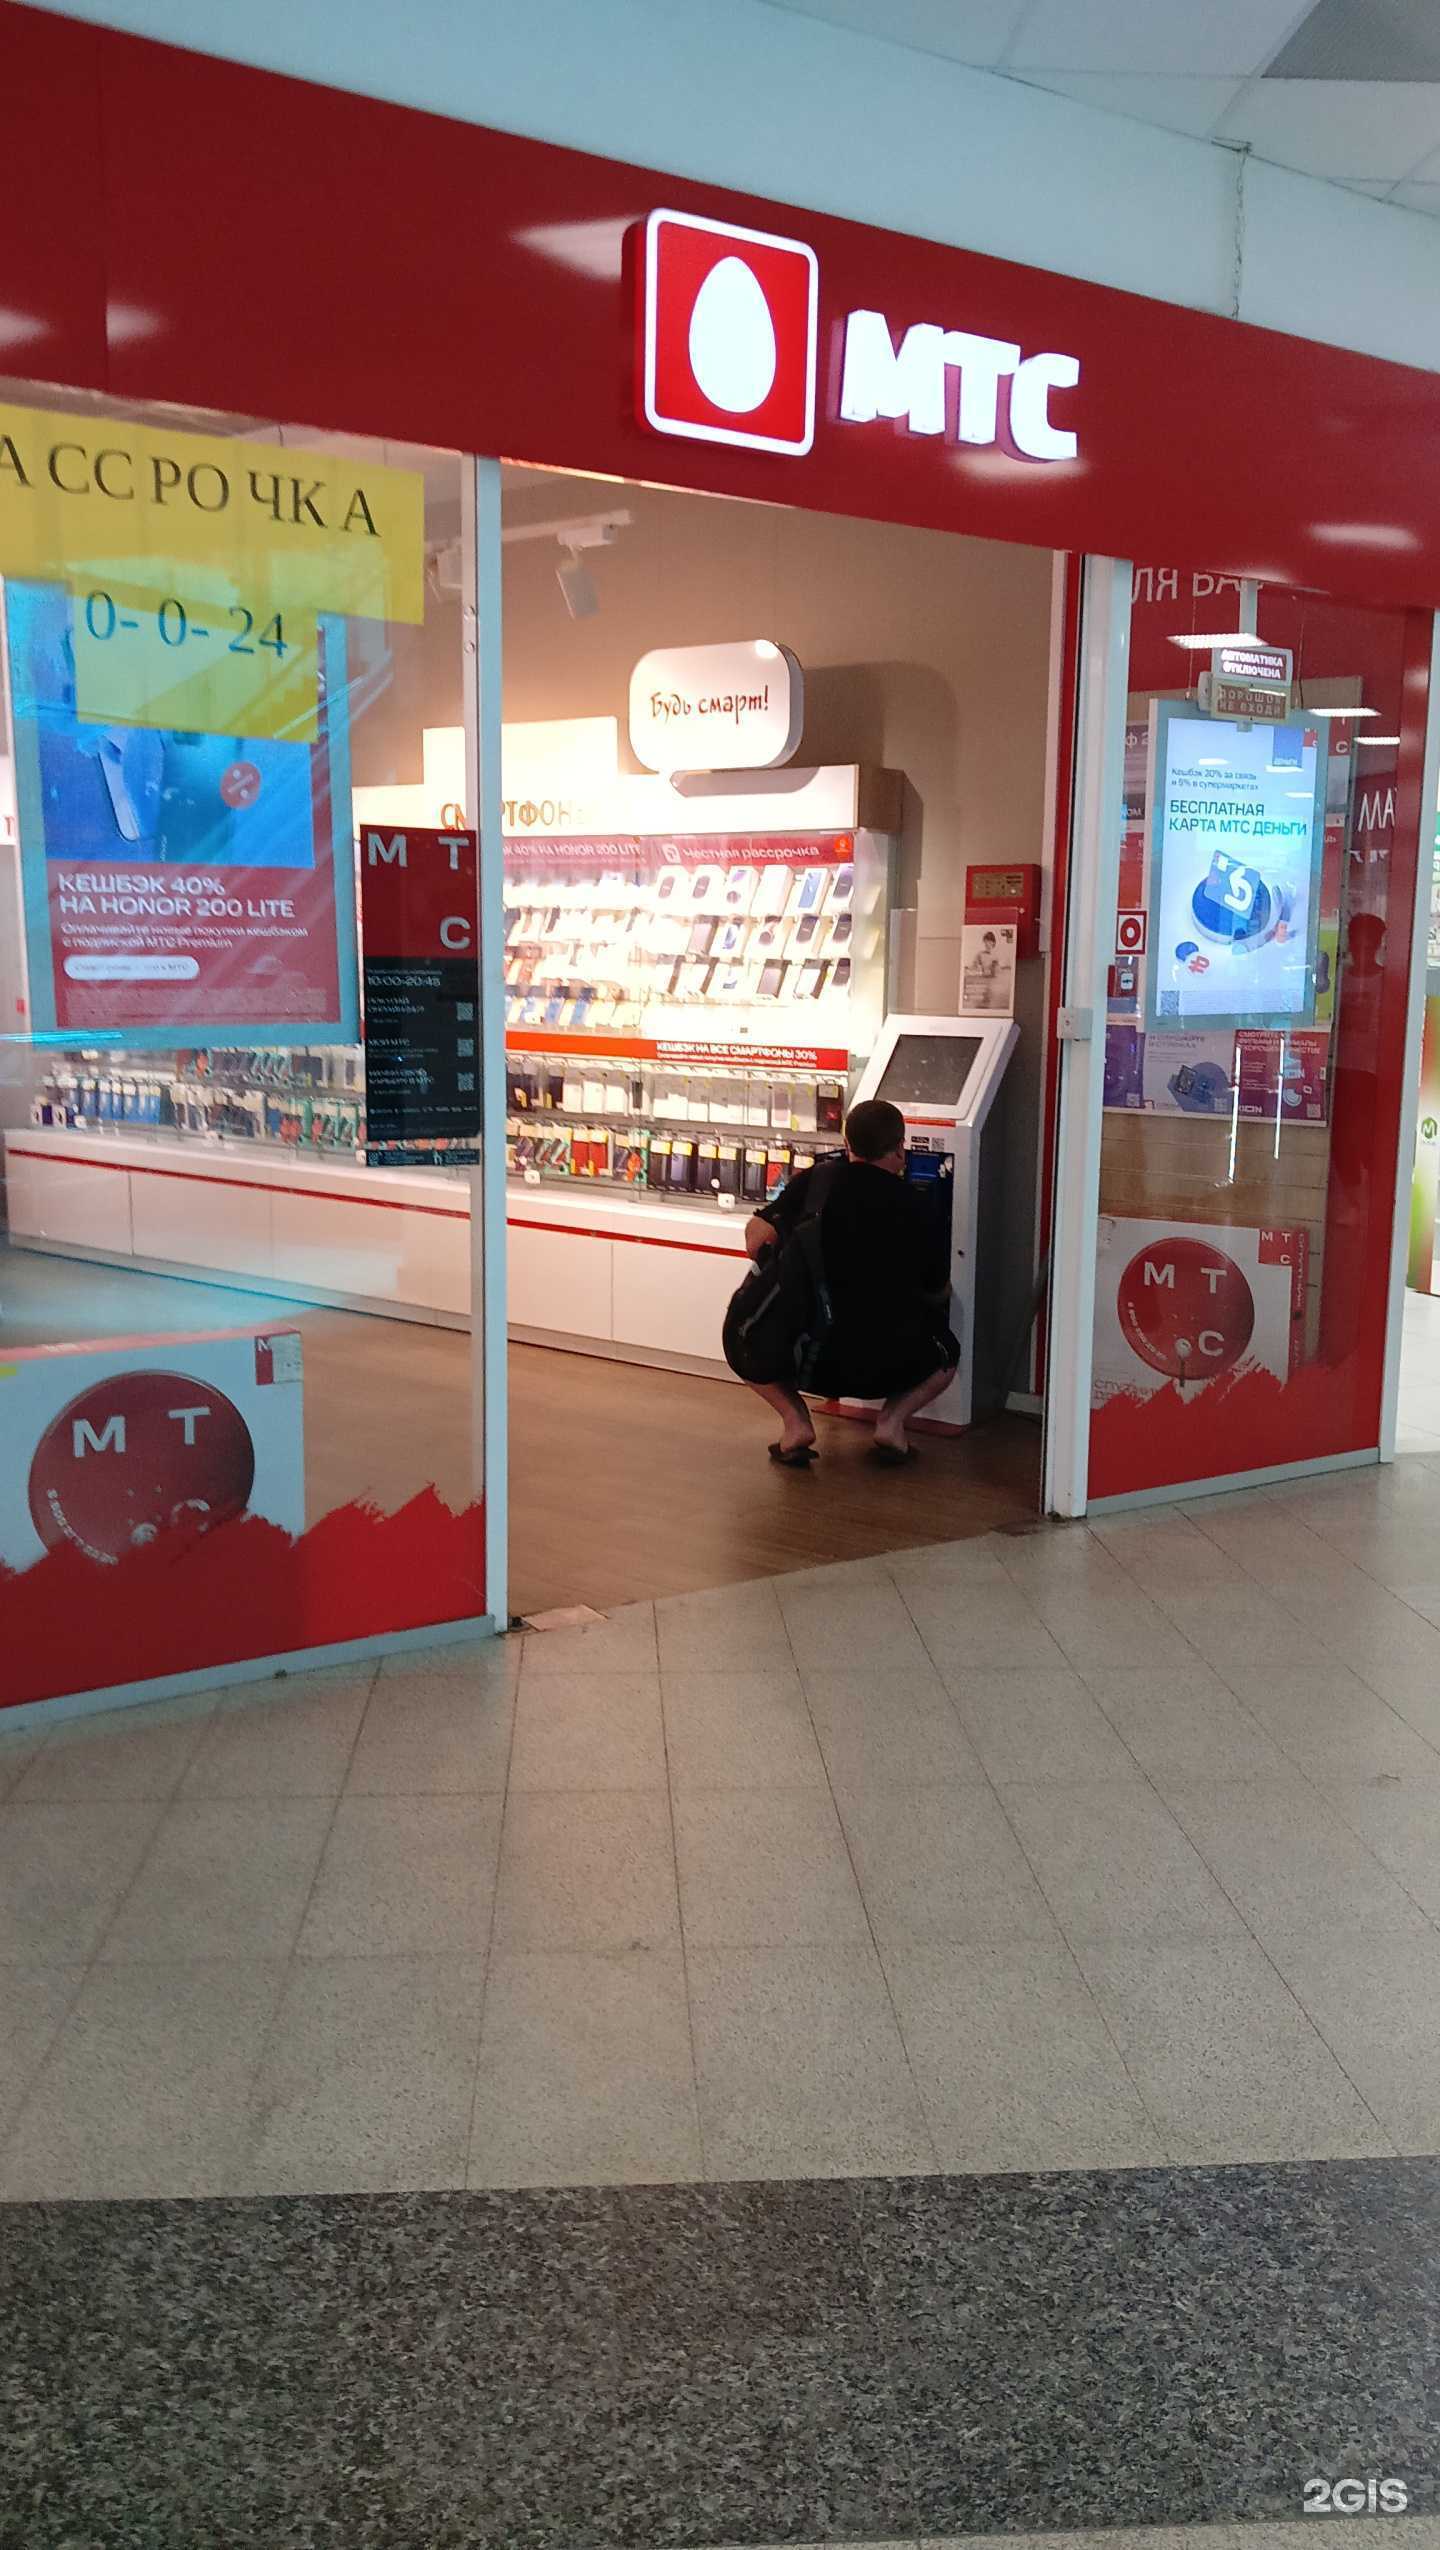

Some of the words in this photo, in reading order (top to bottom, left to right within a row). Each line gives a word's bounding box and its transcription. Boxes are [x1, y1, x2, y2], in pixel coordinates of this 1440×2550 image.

[840, 309, 1080, 461] МТС
[651, 691, 691, 724] Будь
[698, 684, 768, 725] смарт!
[1170, 800, 1264, 816] БЕСПЛАТНАЯ
[1169, 818, 1216, 832] КАРТА
[1220, 820, 1250, 834] МТС
[1253, 821, 1307, 836] ДЕНЬГИ
[57, 873, 165, 894] КЕШБЭК
[171, 877, 226, 896] 40%
[60, 896, 97, 914] НА
[101, 897, 191, 917] HONOR
[196, 899, 242, 919] 200
[248, 900, 296, 919] LITE
